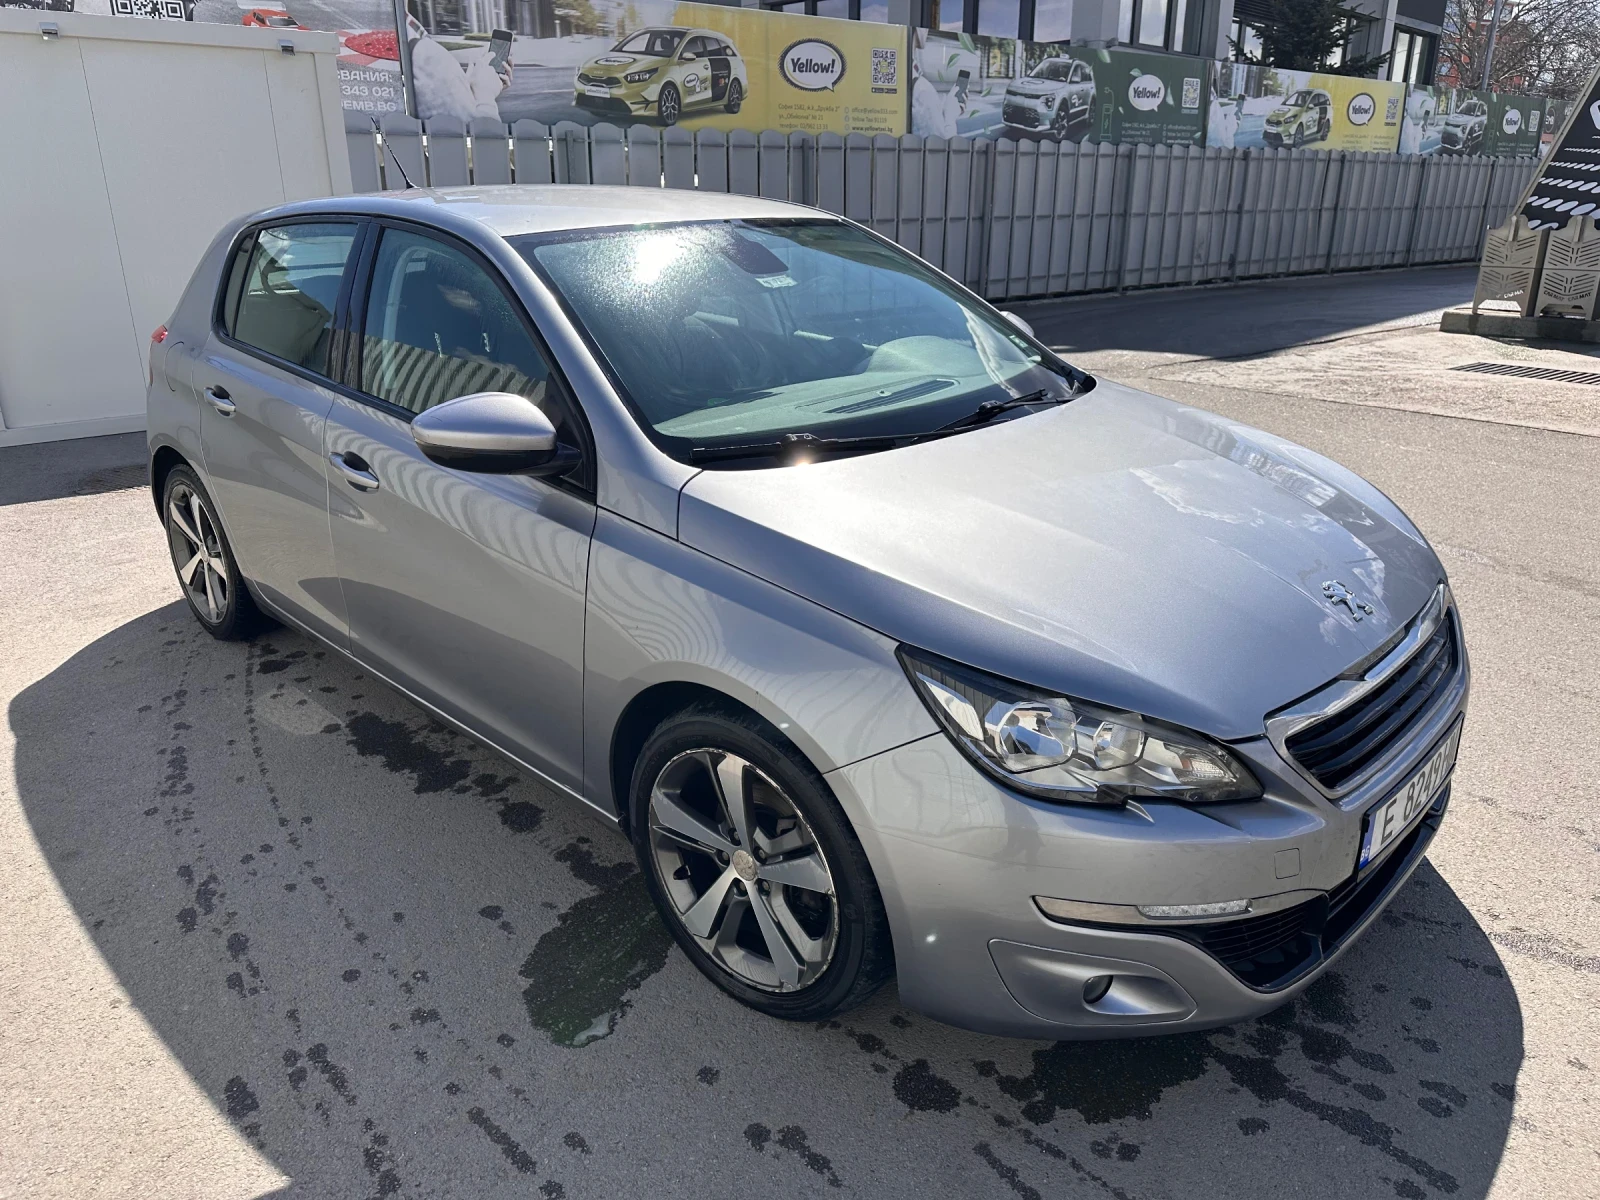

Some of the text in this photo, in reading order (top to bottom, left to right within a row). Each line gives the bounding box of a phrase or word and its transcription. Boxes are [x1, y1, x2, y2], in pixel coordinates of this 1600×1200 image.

[790, 57, 836, 74] Yellow!
[337, 70, 393, 82] ВАНИЯ:
[342, 85, 394, 97] 343 021
[1132, 85, 1161, 100] Yellow!
[1351, 104, 1372, 115] Yellow!
[1380, 797, 1398, 846] E
[1403, 751, 1442, 822] 8249
